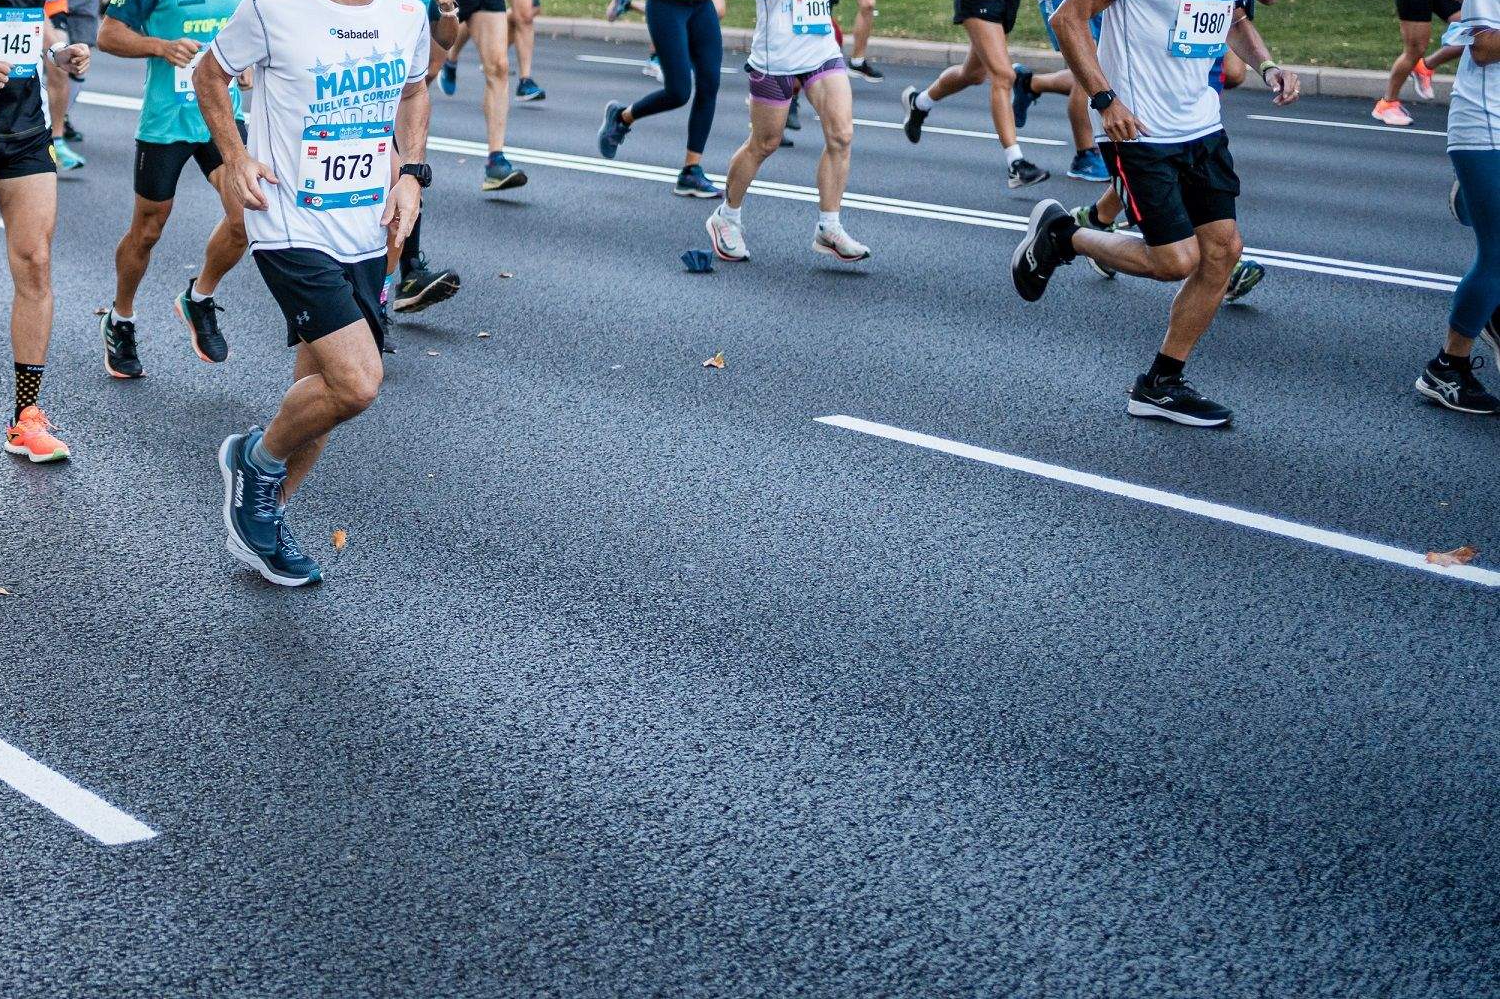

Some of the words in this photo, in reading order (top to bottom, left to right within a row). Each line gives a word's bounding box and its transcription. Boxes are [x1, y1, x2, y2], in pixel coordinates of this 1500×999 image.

[337, 29, 379, 39] Sabadell
[1192, 12, 1225, 34] 1980
[315, 58, 406, 101] MADRID
[309, 97, 350, 114] VUELVE
[352, 95, 360, 105] A
[321, 153, 373, 182] 1673
